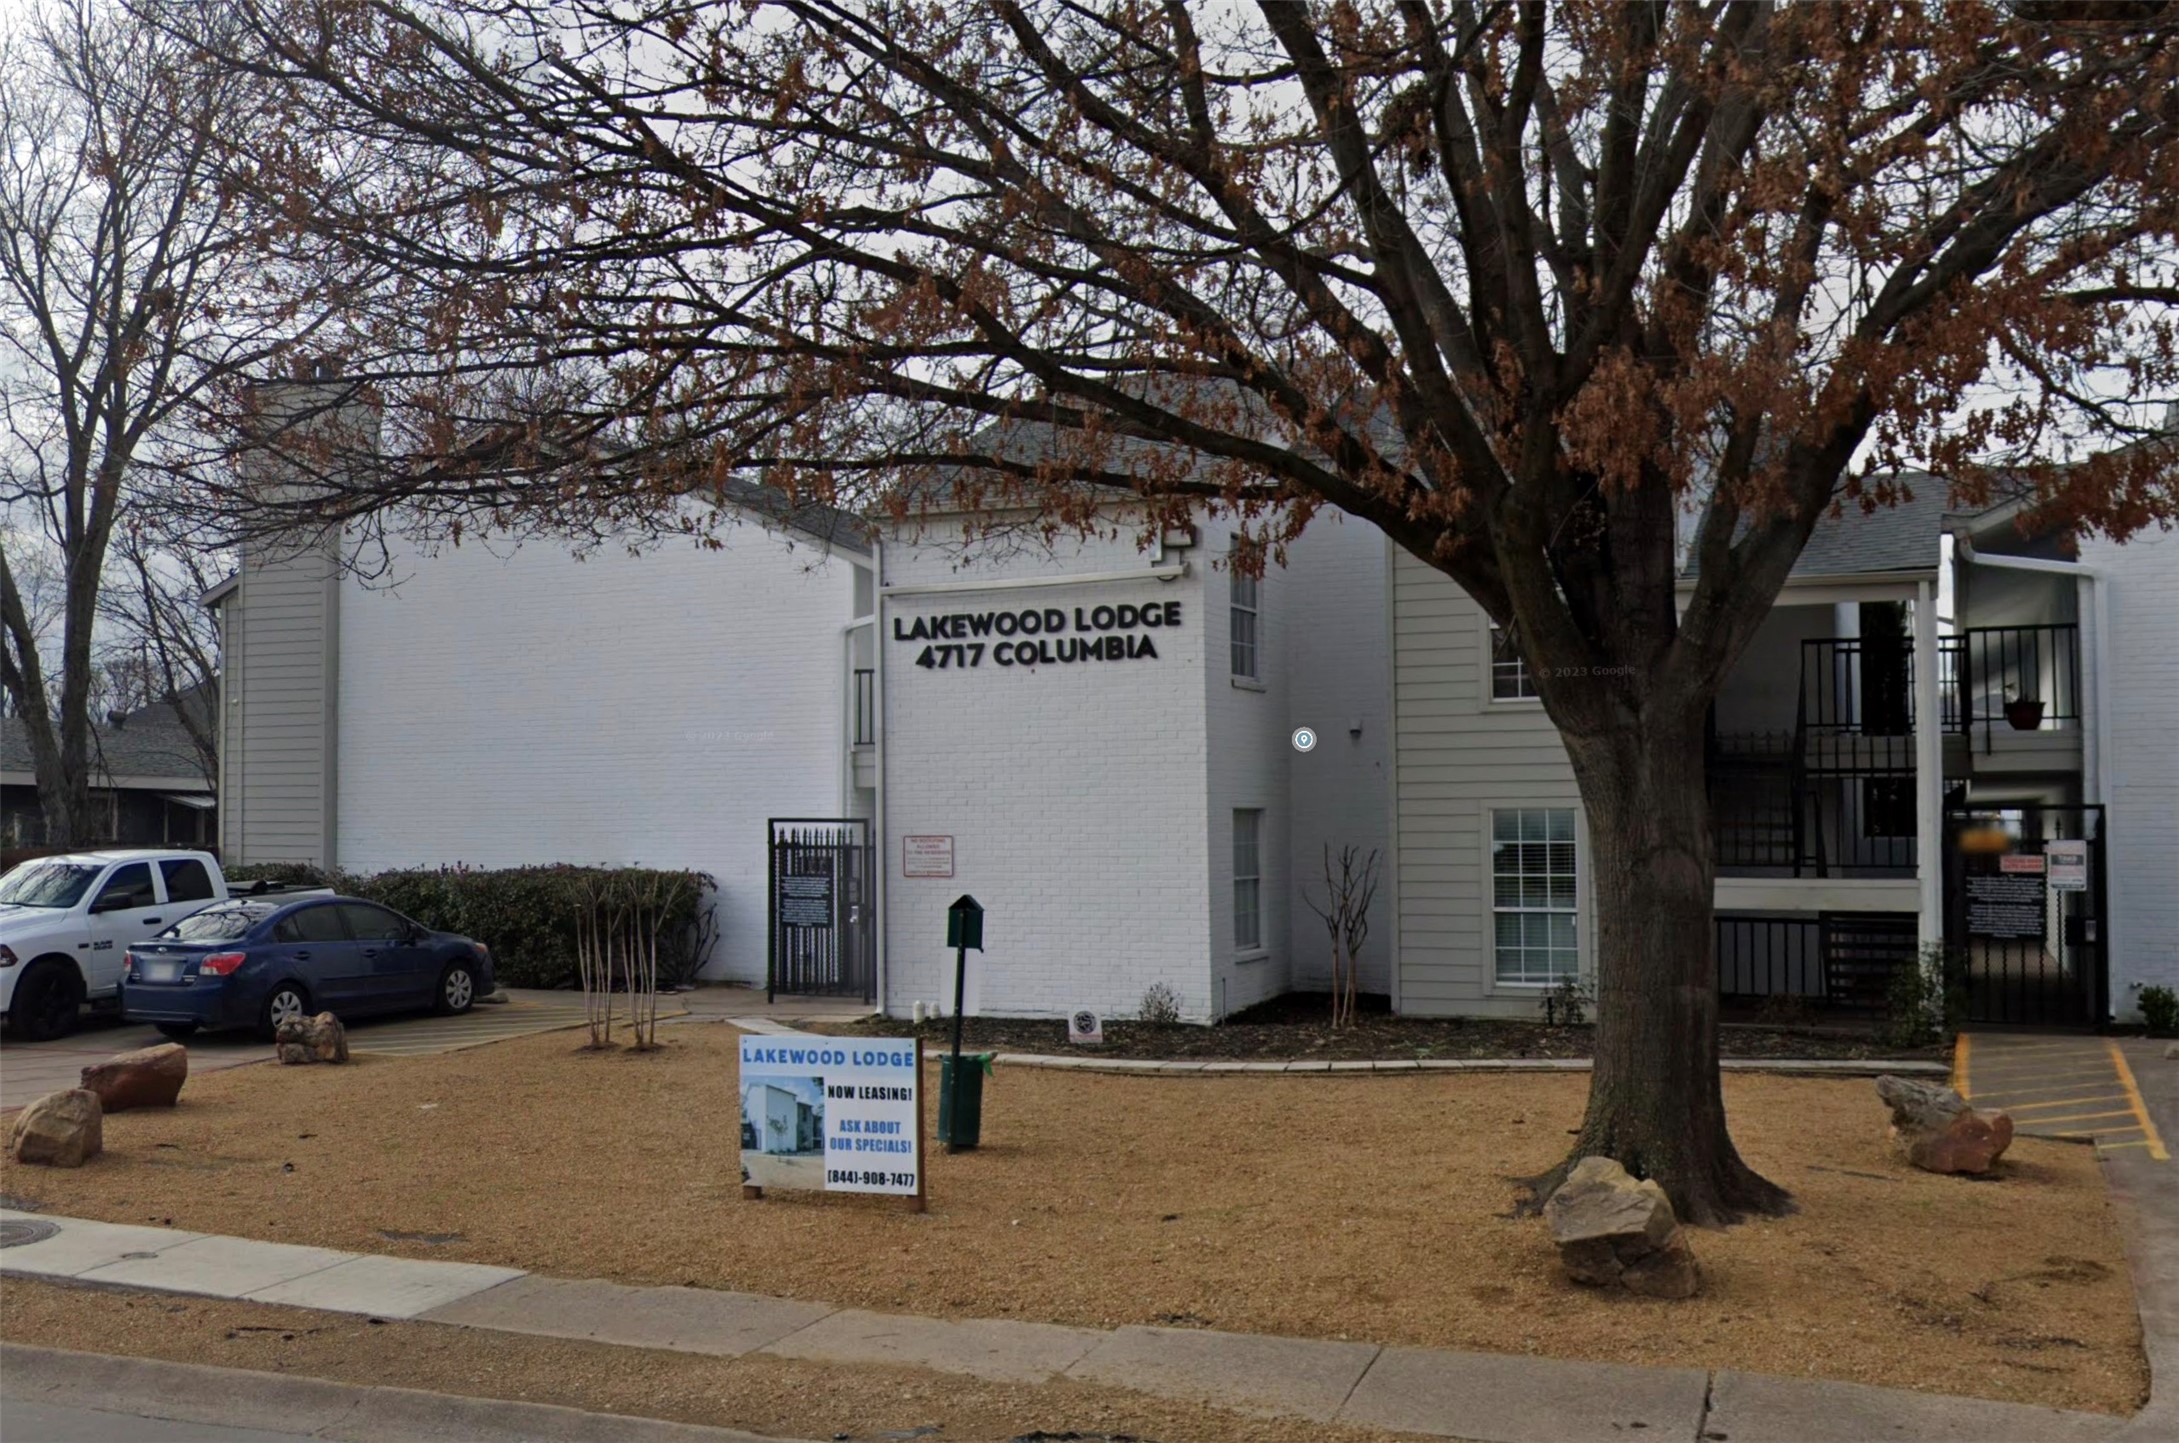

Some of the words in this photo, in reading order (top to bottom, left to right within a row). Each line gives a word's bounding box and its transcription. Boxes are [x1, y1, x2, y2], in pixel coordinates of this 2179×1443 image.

[893, 608, 1066, 641] LAKEWOOD
[1074, 601, 1182, 632] LODGE
[915, 642, 986, 669] 4717
[992, 634, 1158, 666] COLUMBIA
[743, 1048, 845, 1066] LAKEWOOD
[853, 1051, 914, 1067] LODGE
[827, 1085, 855, 1100] NOW
[858, 1086, 912, 1101] LEASING!
[839, 1119, 861, 1133] ASK
[864, 1120, 901, 1134] ABOUT
[829, 1137, 852, 1151] OUR
[855, 1138, 912, 1154] SPECIALS!
[827, 1169, 915, 1188] (844)-908-7477
